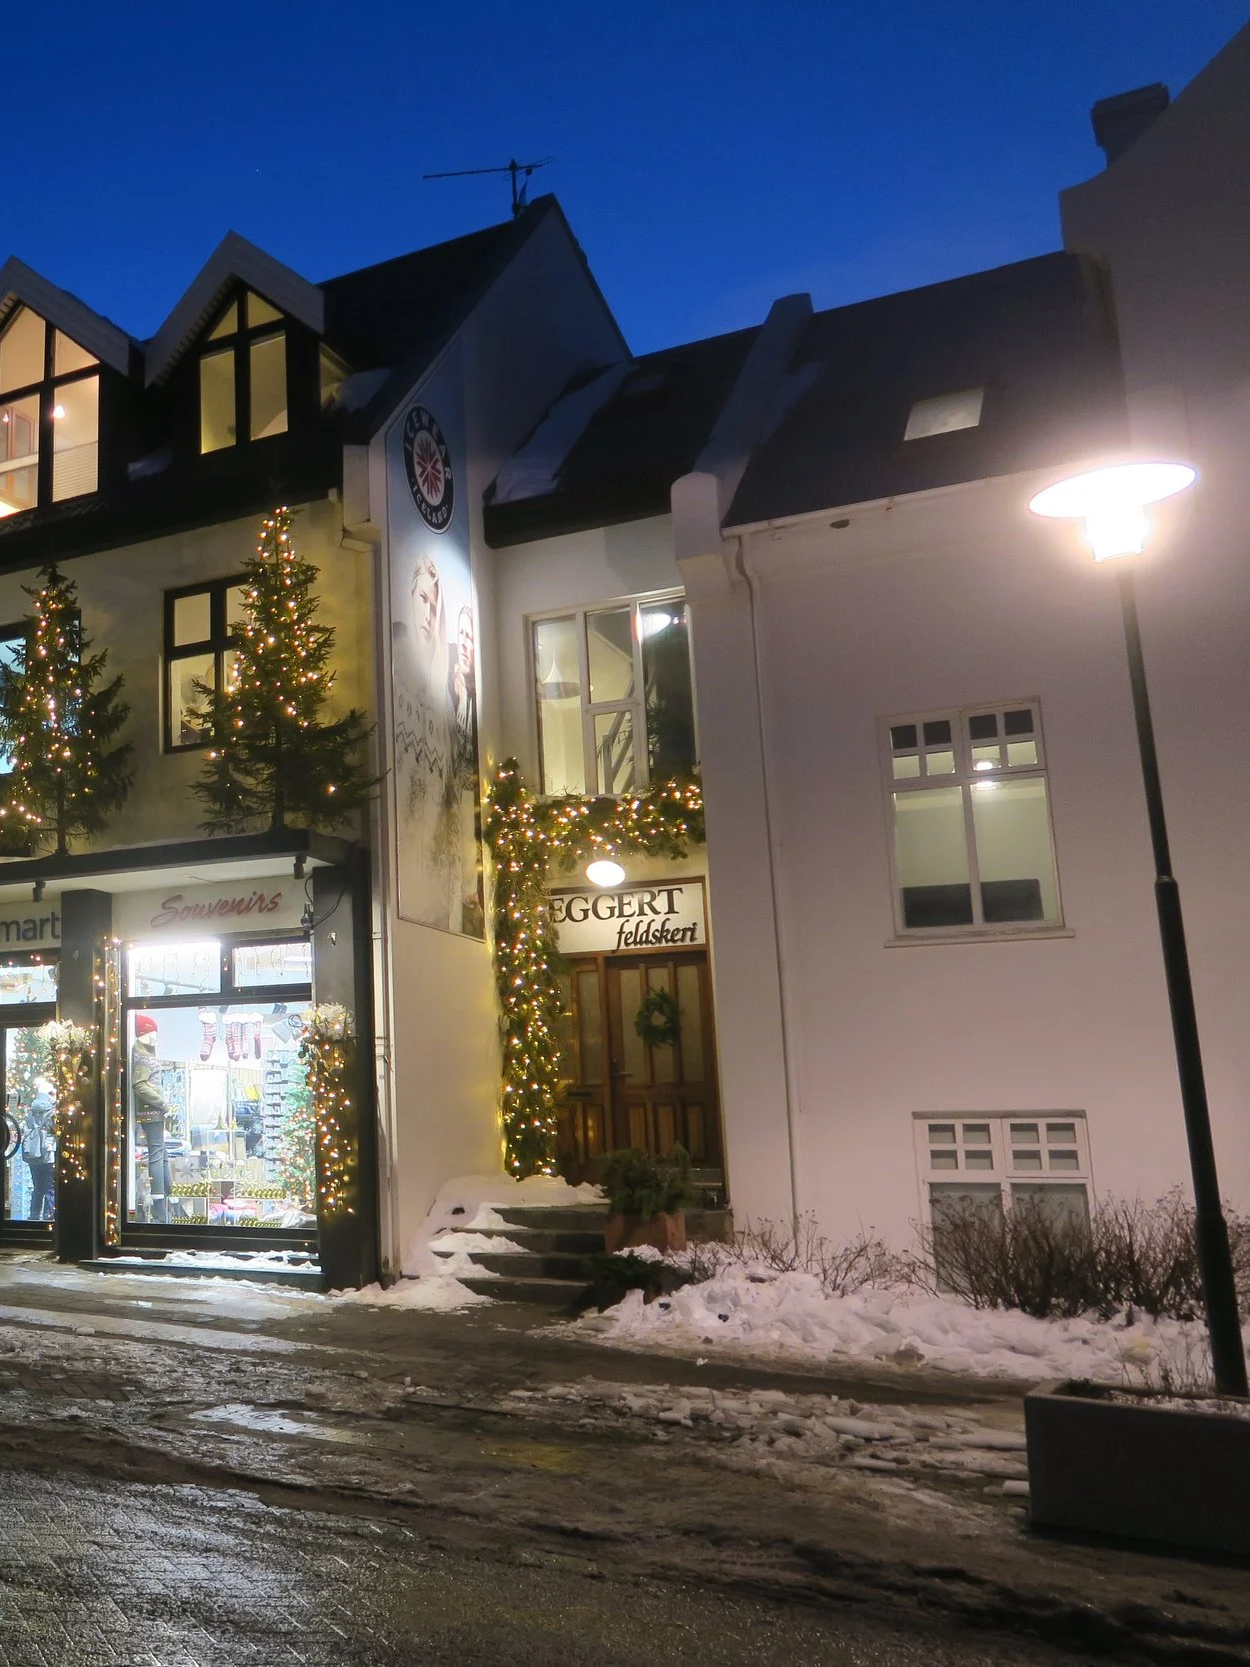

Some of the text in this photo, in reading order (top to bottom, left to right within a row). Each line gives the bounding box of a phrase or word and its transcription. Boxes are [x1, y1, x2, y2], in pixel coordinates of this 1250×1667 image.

[405, 409, 452, 480] ICEWEAR
[413, 483, 448, 523] ICELAND
[151, 891, 282, 928] Souvenirs
[550, 888, 683, 923] EGGERT
[611, 918, 698, 954] feldskeri
